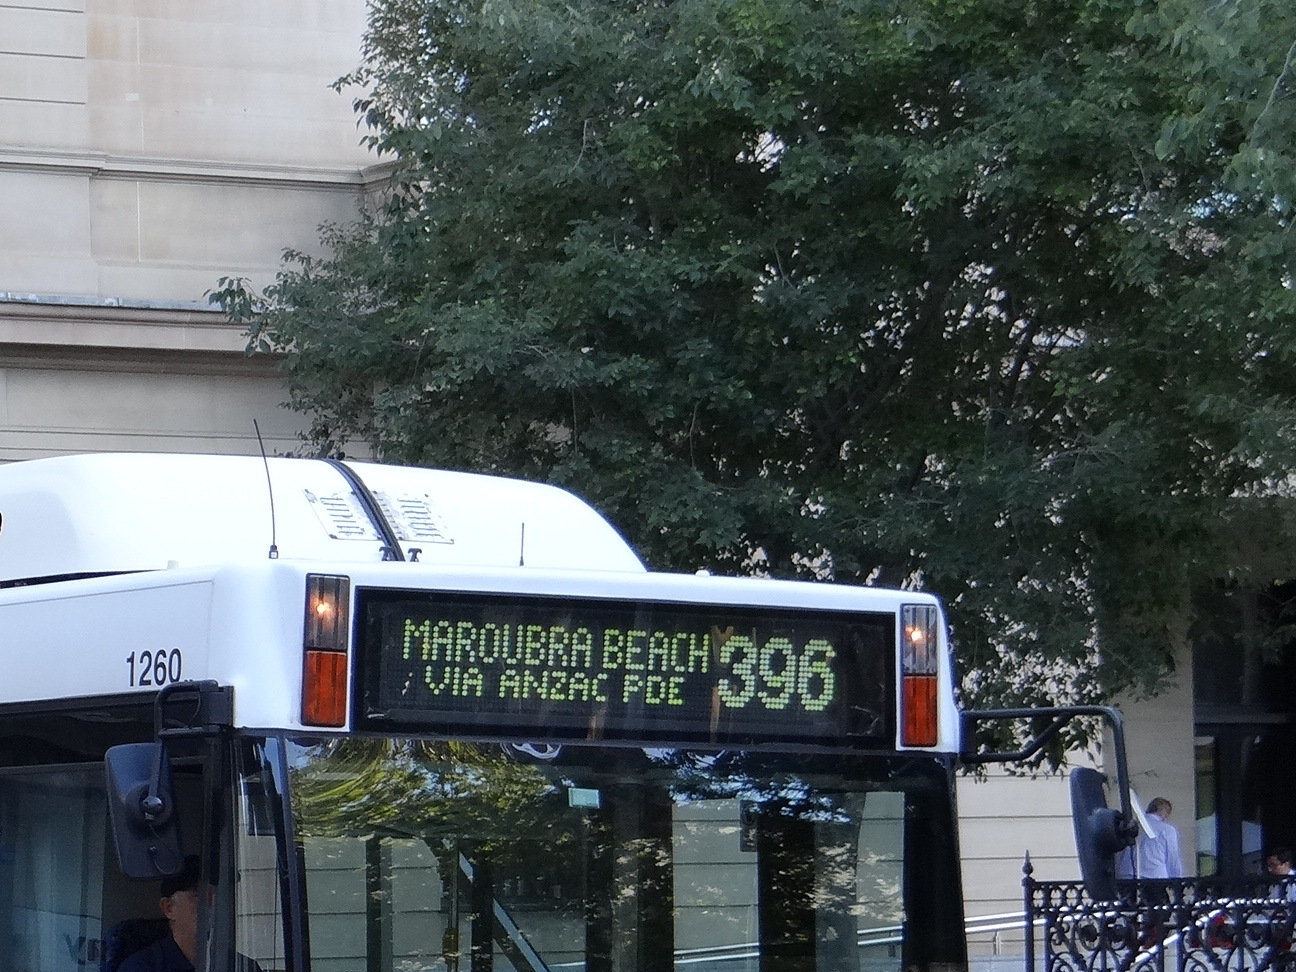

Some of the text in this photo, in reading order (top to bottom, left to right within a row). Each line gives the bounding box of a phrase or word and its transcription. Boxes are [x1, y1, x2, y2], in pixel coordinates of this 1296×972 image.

[126, 648, 182, 687] 1260
[403, 618, 709, 675] MAROUBRA BEACH
[423, 665, 686, 706] VIA ANZAC PDE
[718, 635, 837, 713] 396
